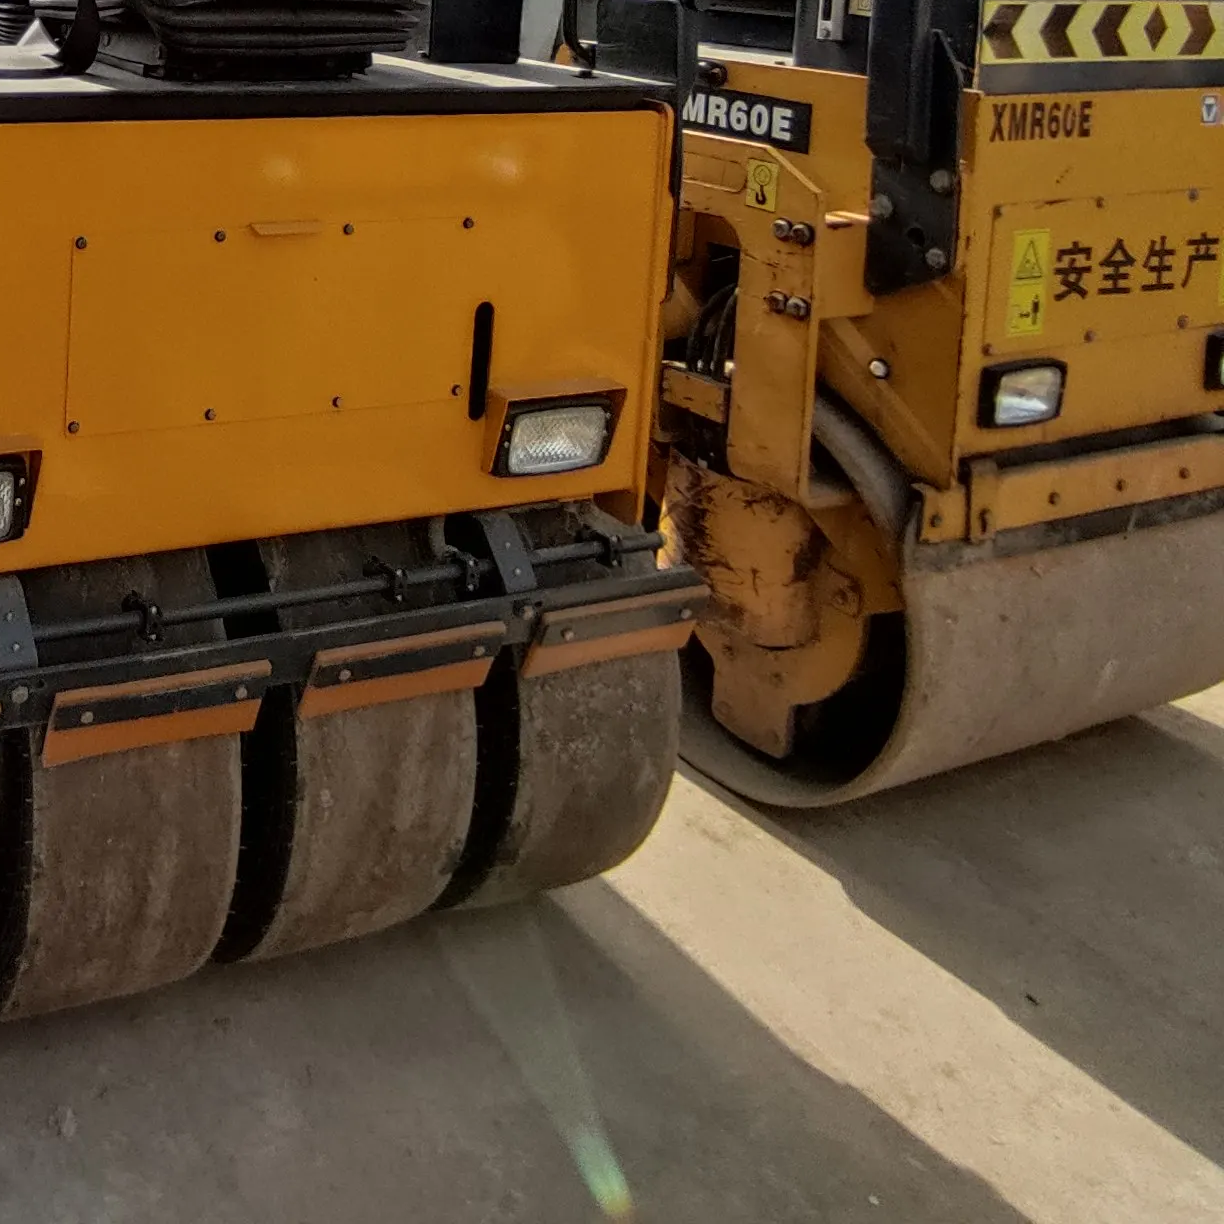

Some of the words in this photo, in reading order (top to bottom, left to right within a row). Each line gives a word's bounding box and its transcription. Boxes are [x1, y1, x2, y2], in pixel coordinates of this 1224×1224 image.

[989, 100, 1093, 142] XMR60E
[1053, 232, 1219, 302] 安全生产
